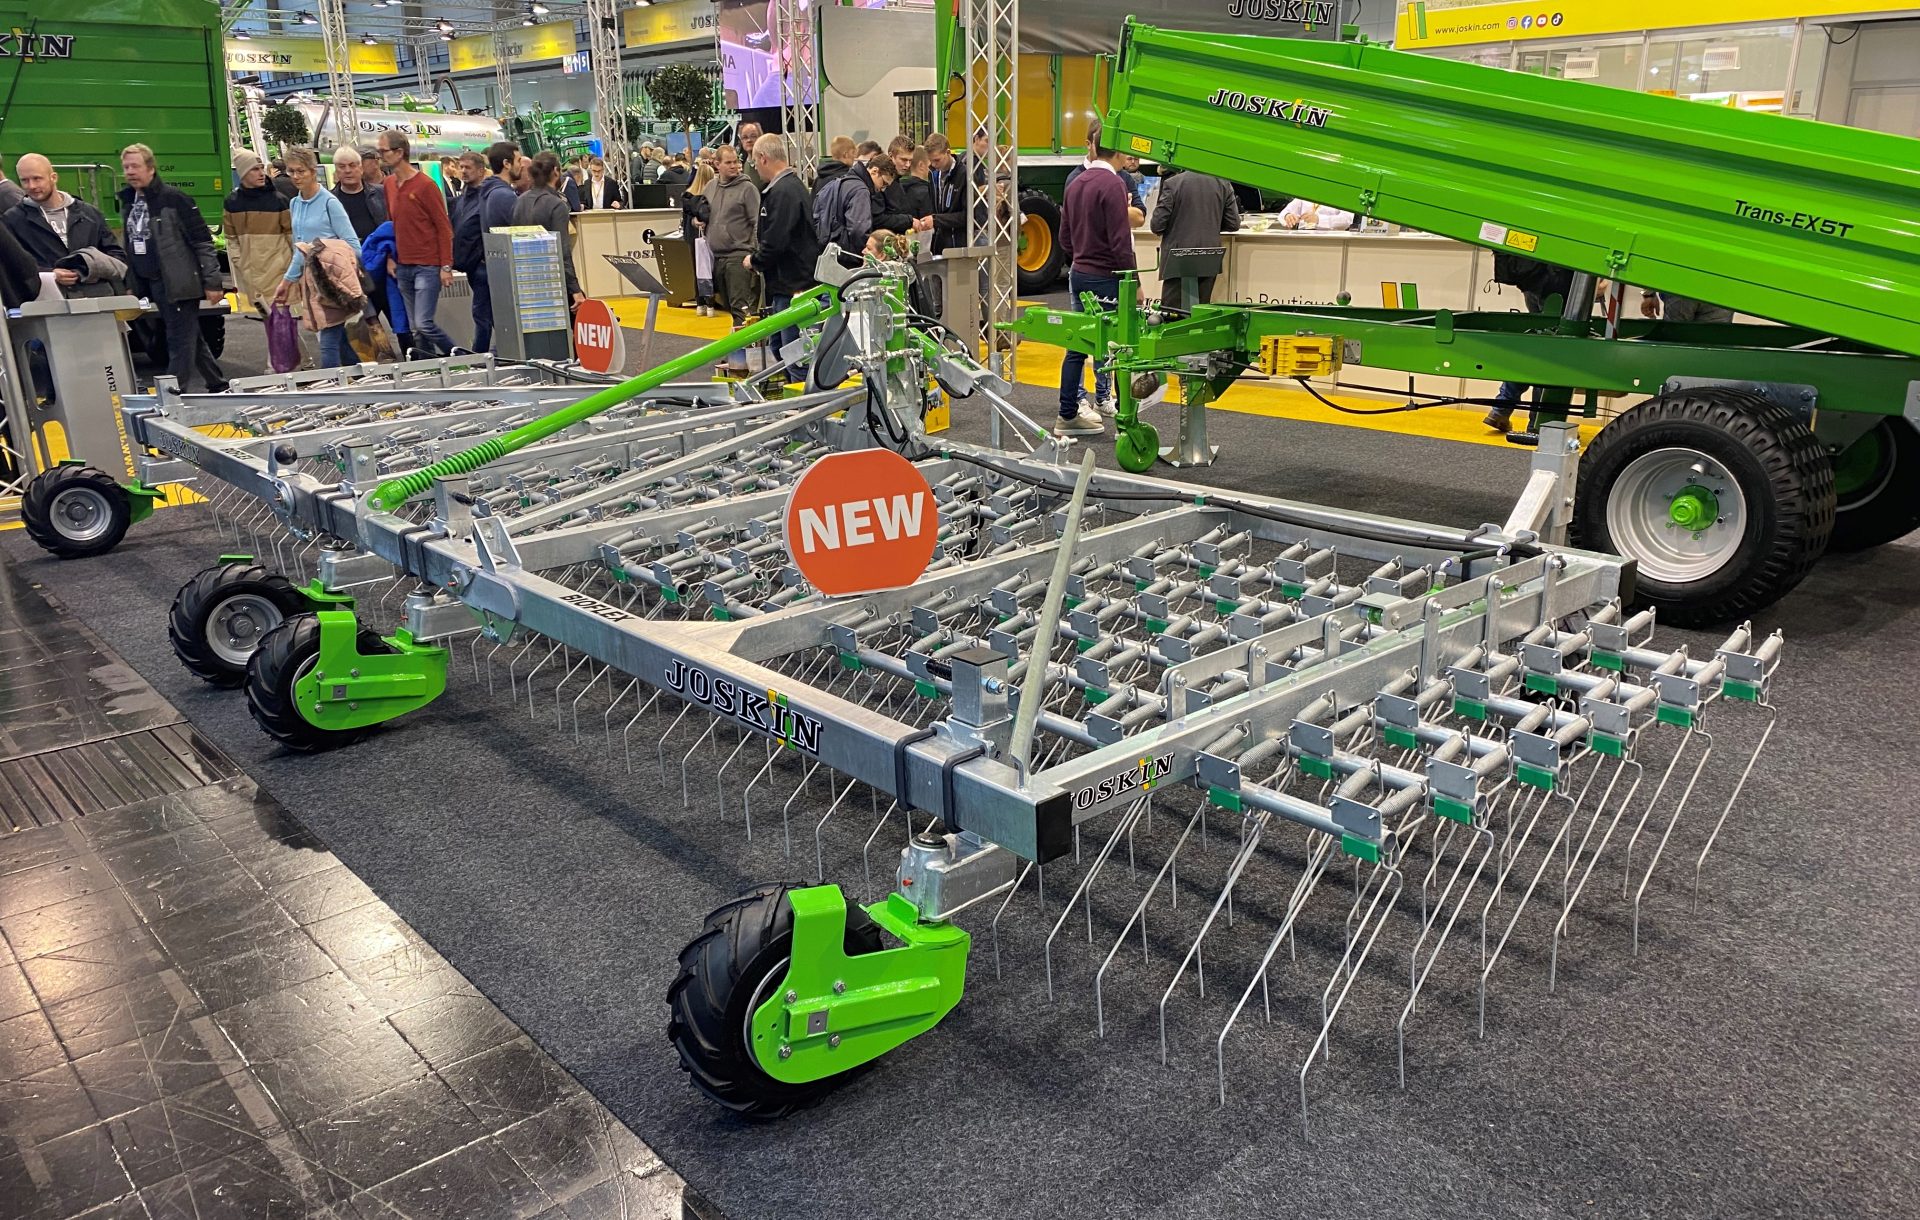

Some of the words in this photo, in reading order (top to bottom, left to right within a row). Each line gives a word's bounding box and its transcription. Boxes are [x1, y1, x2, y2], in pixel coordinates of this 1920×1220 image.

[1228, 0, 1334, 25] JOSKIN
[1434, 22, 1500, 35] www.joskin.com
[226, 52, 292, 65] JOSKIN
[1208, 88, 1333, 128] JOSKIN
[577, 322, 611, 349] NEW
[798, 491, 925, 554] NEW
[559, 593, 636, 623] BIOFLEX
[664, 658, 824, 756] JOSKIN
[1070, 751, 1176, 810] OSKIN
